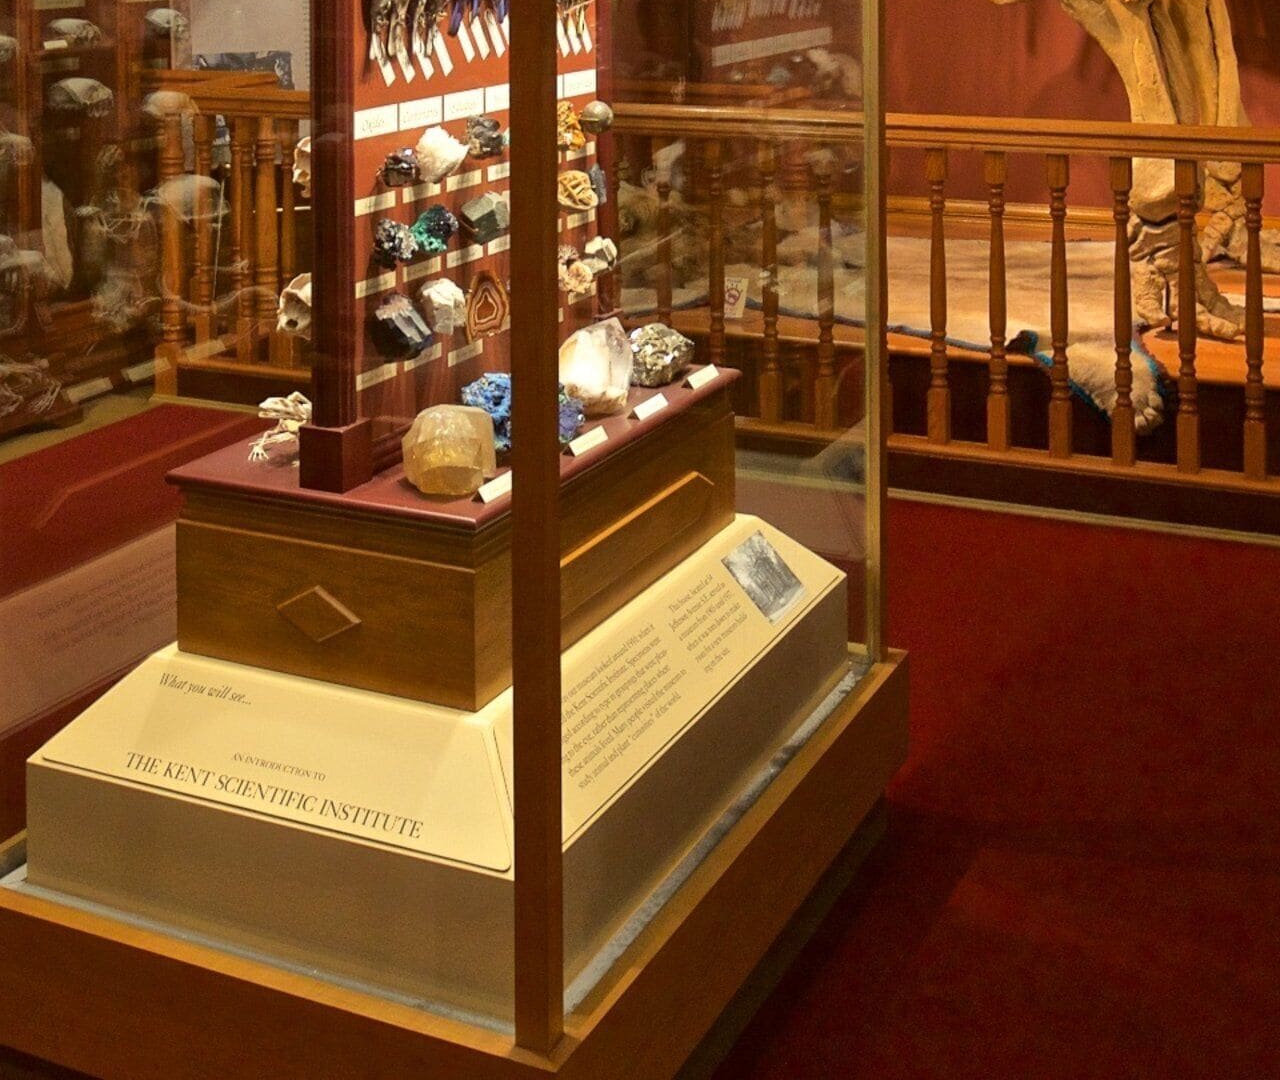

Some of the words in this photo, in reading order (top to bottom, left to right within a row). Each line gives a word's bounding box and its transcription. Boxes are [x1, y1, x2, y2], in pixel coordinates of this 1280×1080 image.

[160, 672, 188, 690] What
[183, 682, 207, 695] you
[207, 685, 232, 699] will
[228, 693, 252, 705] see...
[232, 752, 243, 762] AN
[244, 756, 312, 778] INTRODUCTION
[312, 771, 326, 782] TO
[125, 751, 162, 775] THE
[163, 761, 216, 787] KENT
[214, 773, 318, 813] SCIENTIFIC
[319, 798, 424, 839] INSTITUTE
